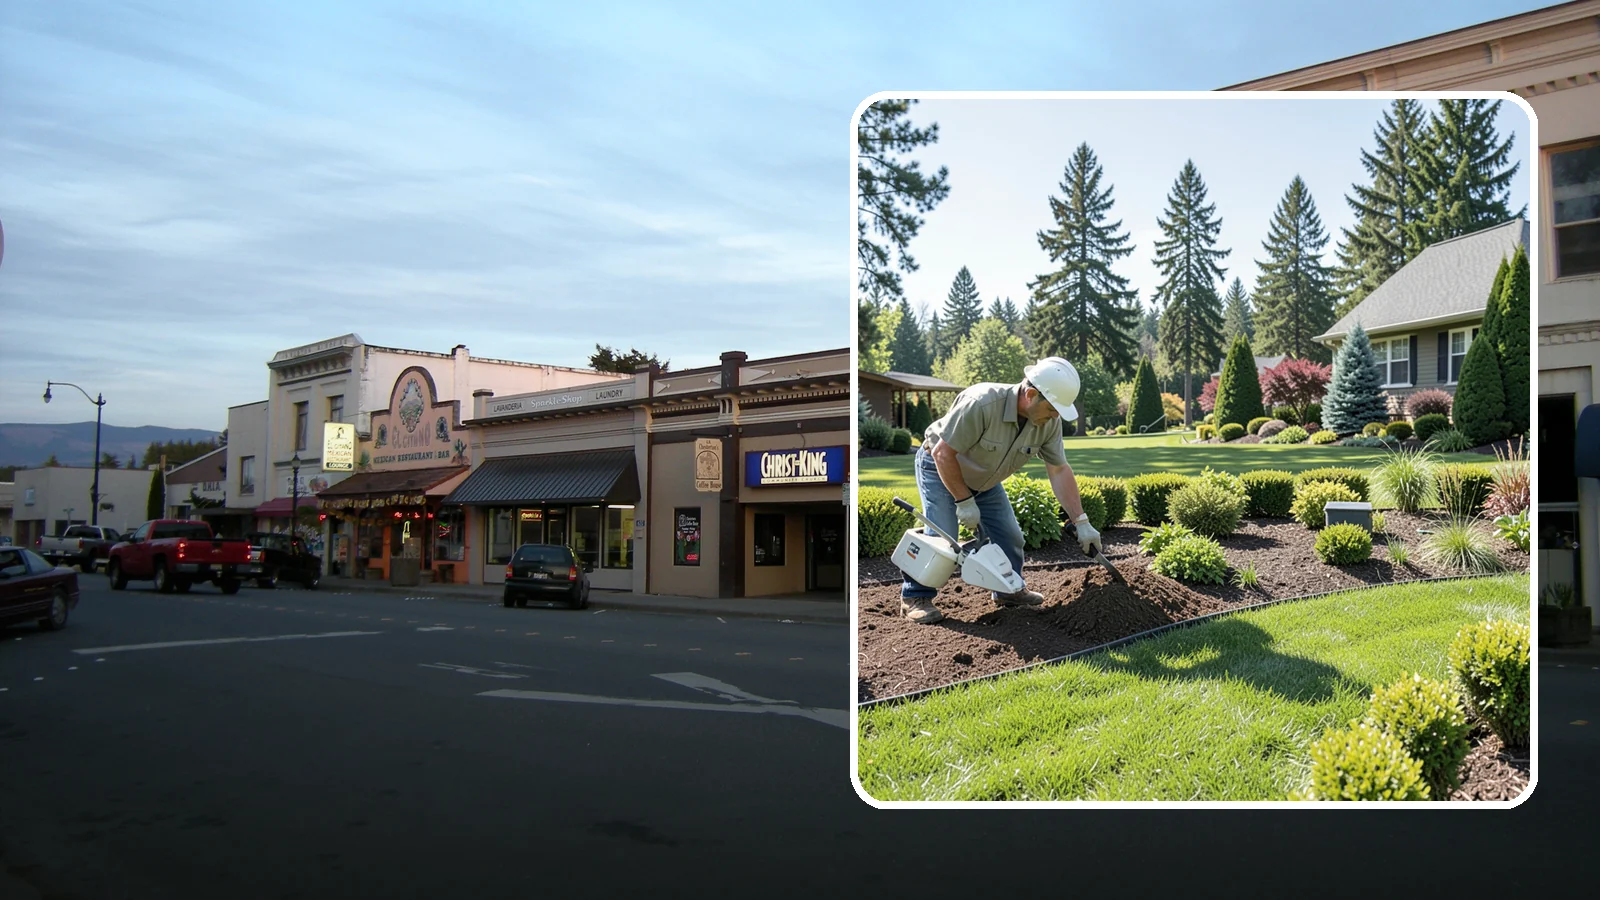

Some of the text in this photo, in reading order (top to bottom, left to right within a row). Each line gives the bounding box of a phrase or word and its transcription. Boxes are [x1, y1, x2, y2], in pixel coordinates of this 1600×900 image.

[595, 389, 623, 400] LAUNDRY
[493, 402, 523, 412] LAVANDERIA
[531, 395, 582, 409] Sparkle Shop
[392, 425, 401, 449] EL
[374, 455, 396, 464] MEXICAN
[397, 451, 433, 462] RESTAURANT
[438, 450, 449, 459] BAR
[761, 450, 827, 478] CHRIST KING
